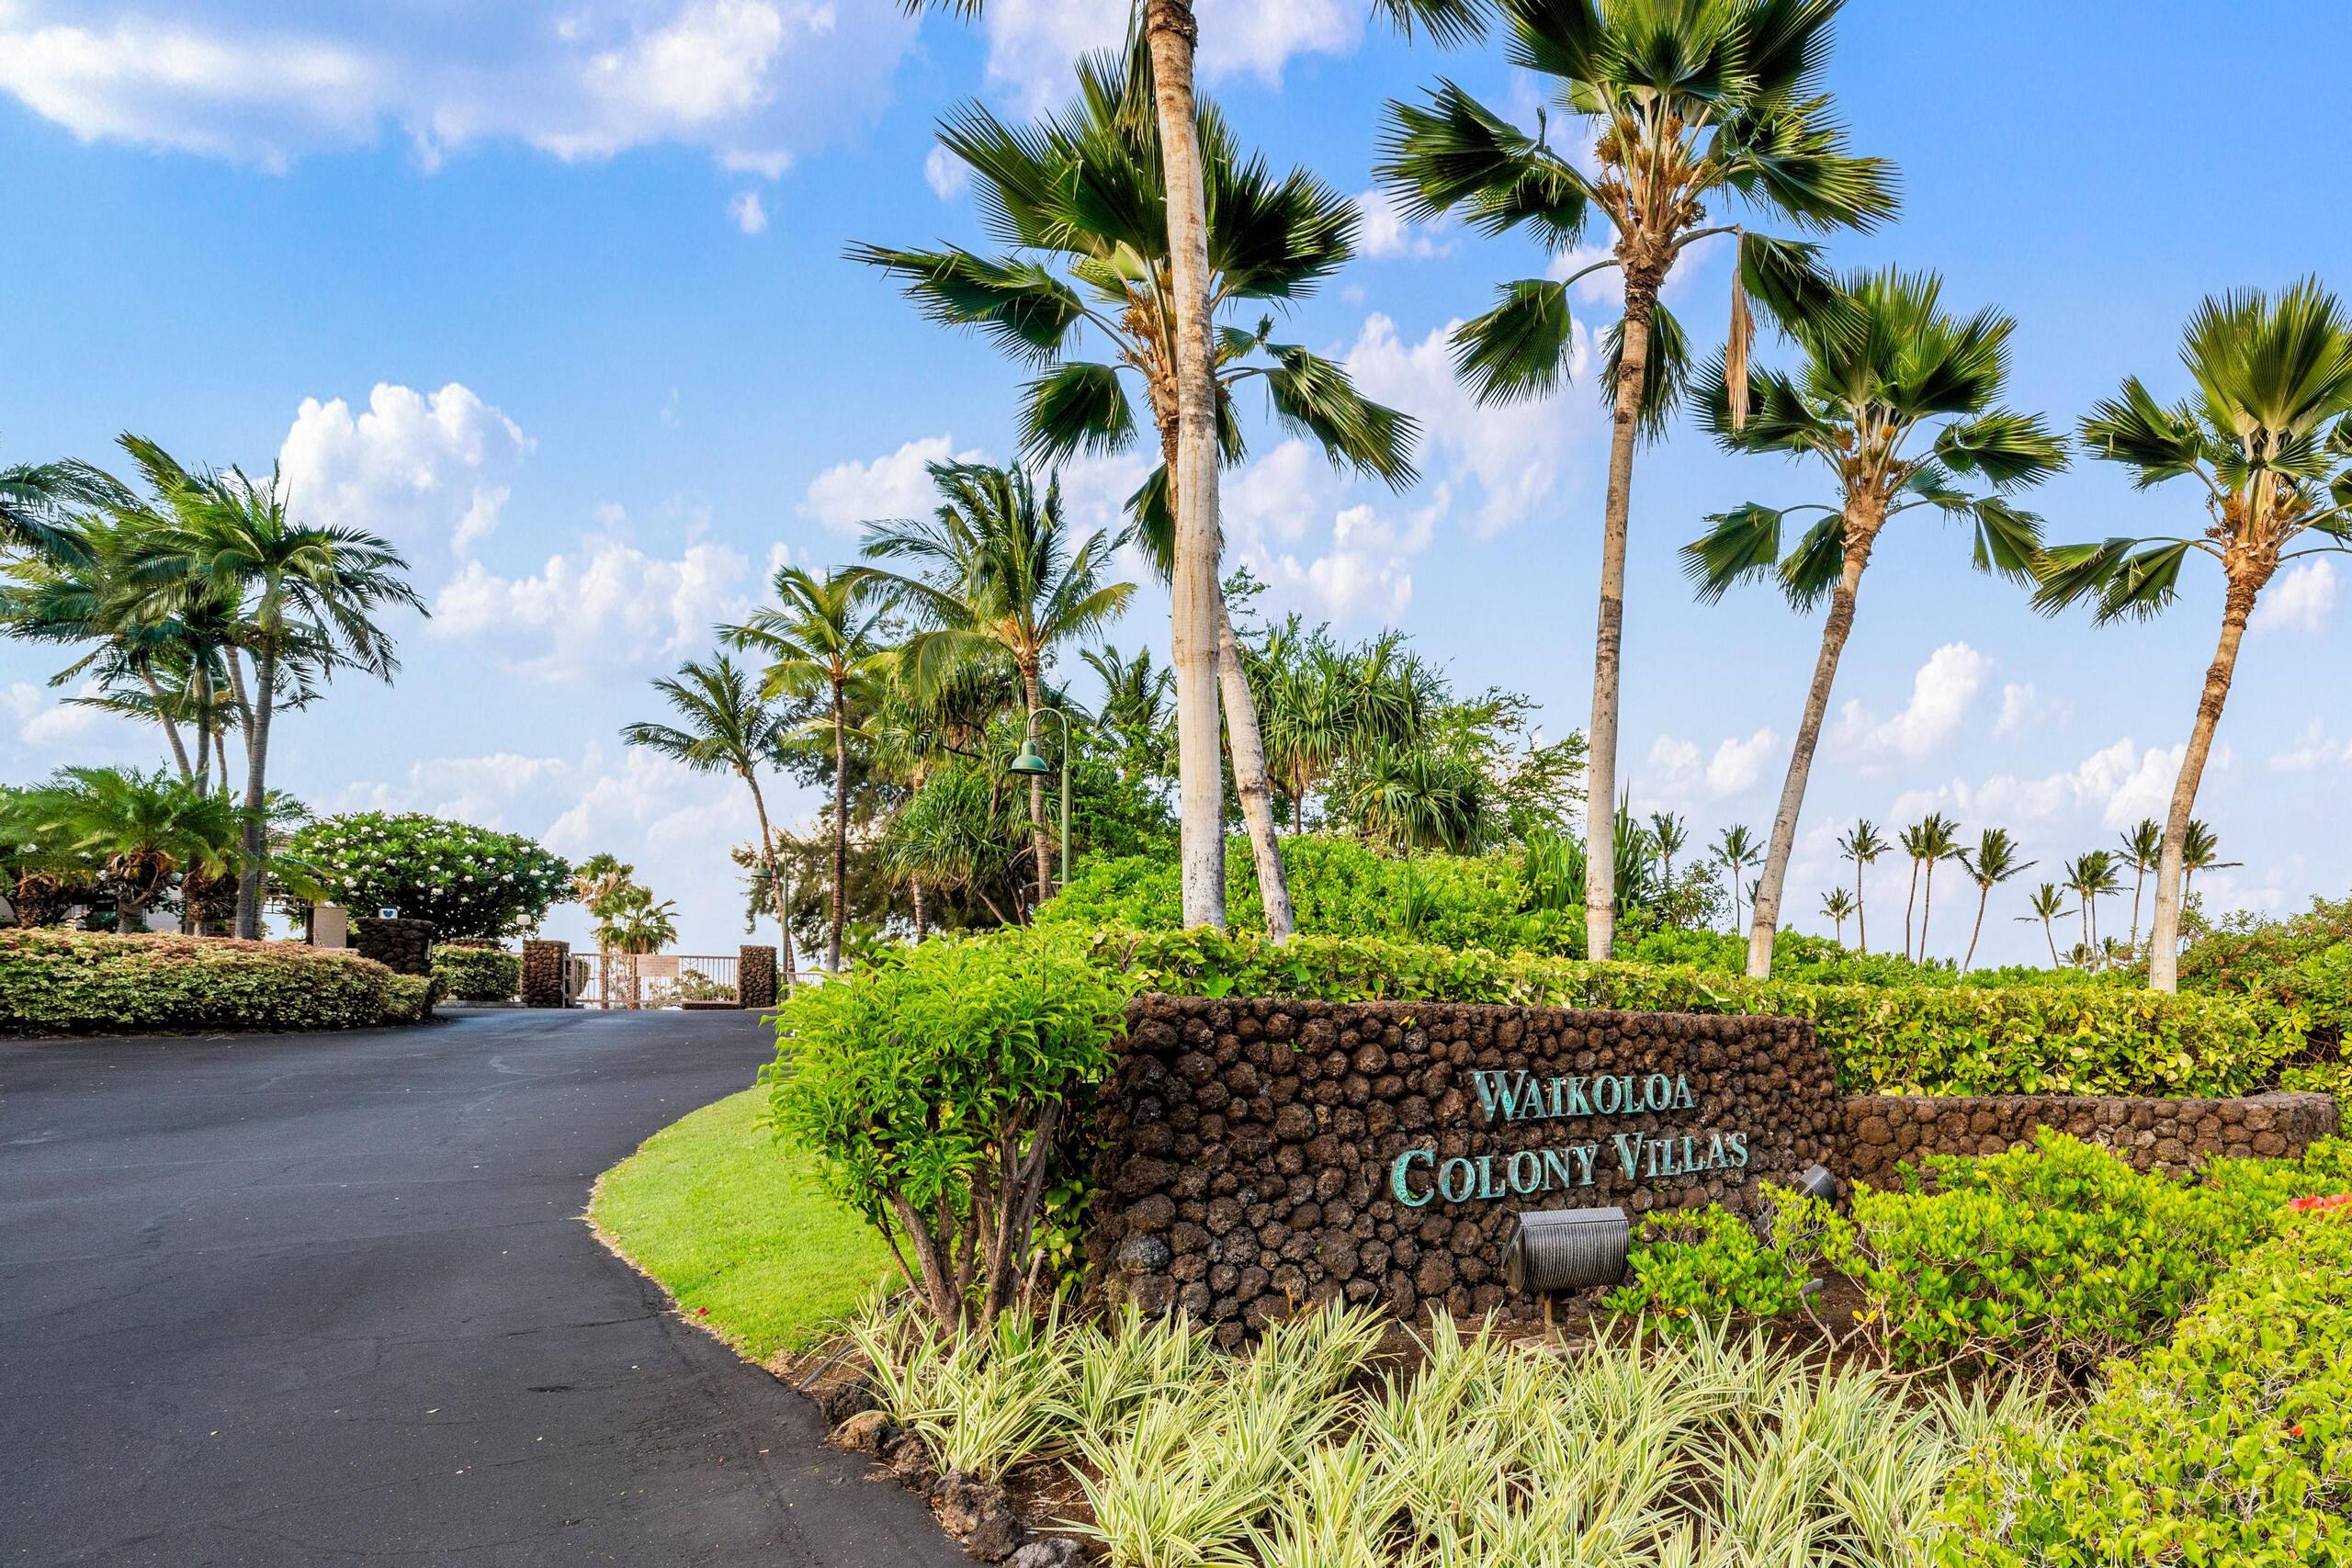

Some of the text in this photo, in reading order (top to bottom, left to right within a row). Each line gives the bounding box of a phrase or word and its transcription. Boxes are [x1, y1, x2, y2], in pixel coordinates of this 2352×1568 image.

[1470, 1069, 1695, 1122] WAIKOLOA
[1391, 1132, 1748, 1207] COLONY VILLAS
